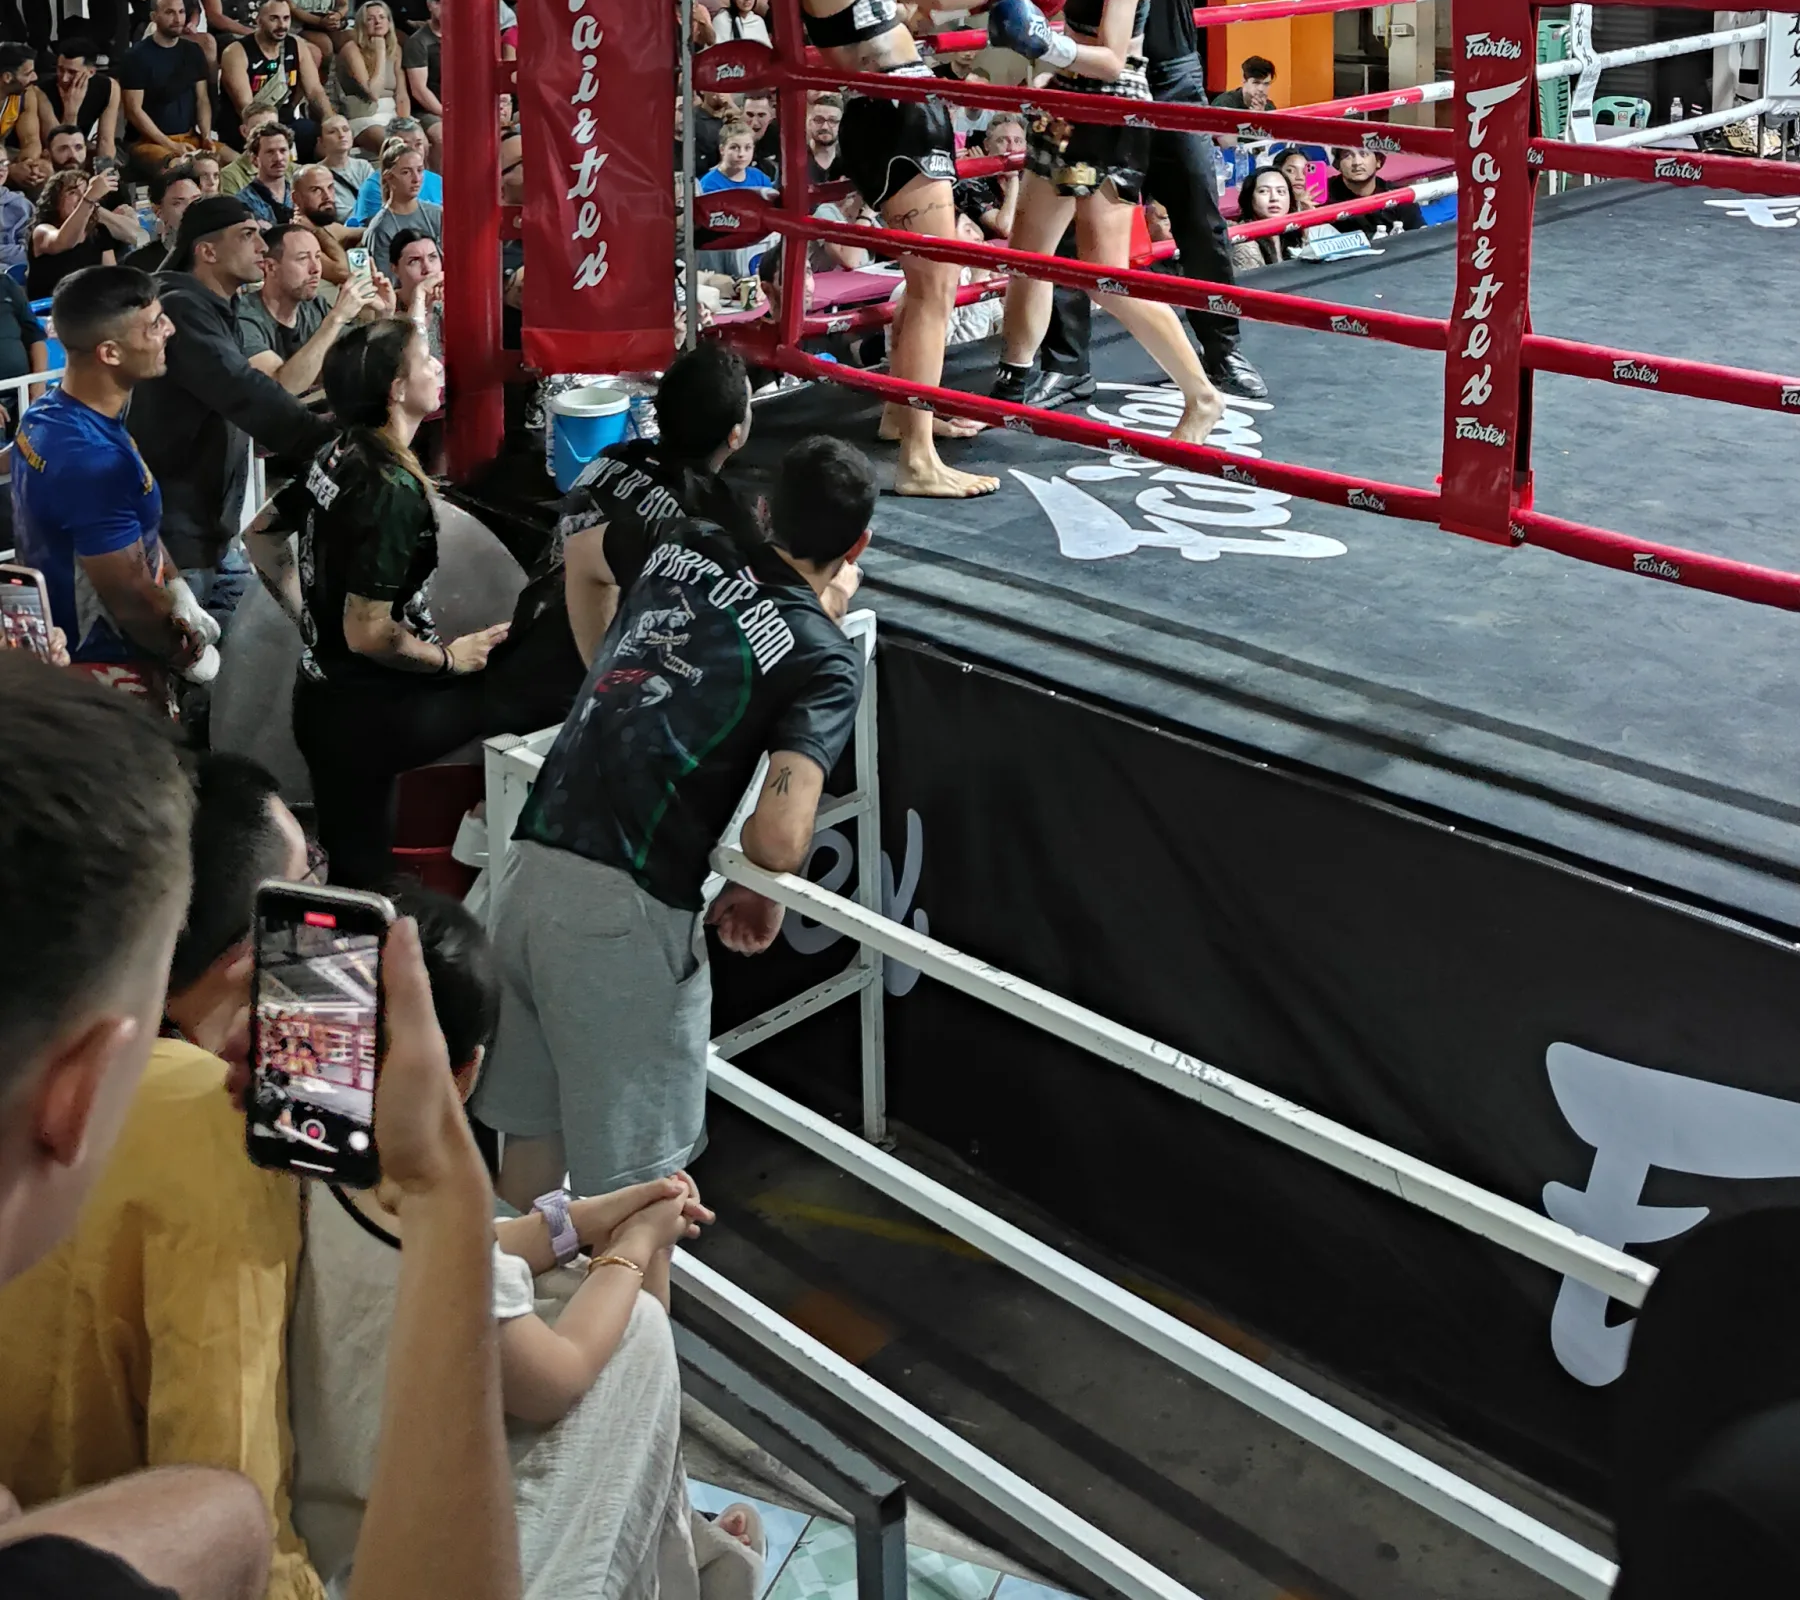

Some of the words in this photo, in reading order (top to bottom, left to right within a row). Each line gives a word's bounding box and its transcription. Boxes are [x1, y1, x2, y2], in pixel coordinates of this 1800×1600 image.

[1464, 31, 1522, 60] Fairtex
[1361, 132, 1402, 152] Fairtex
[1655, 157, 1703, 181] Fairtex
[1460, 76, 1529, 406] Fairtex
[1207, 294, 1242, 315] Fairtex
[1330, 315, 1369, 335] Fairtex
[1612, 360, 1659, 385] Fairtex
[1455, 416, 1507, 447] Fairtex
[1346, 488, 1387, 511] Fairtex
[1632, 553, 1681, 580] Fairtex
[736, 599, 795, 675] SIAM
